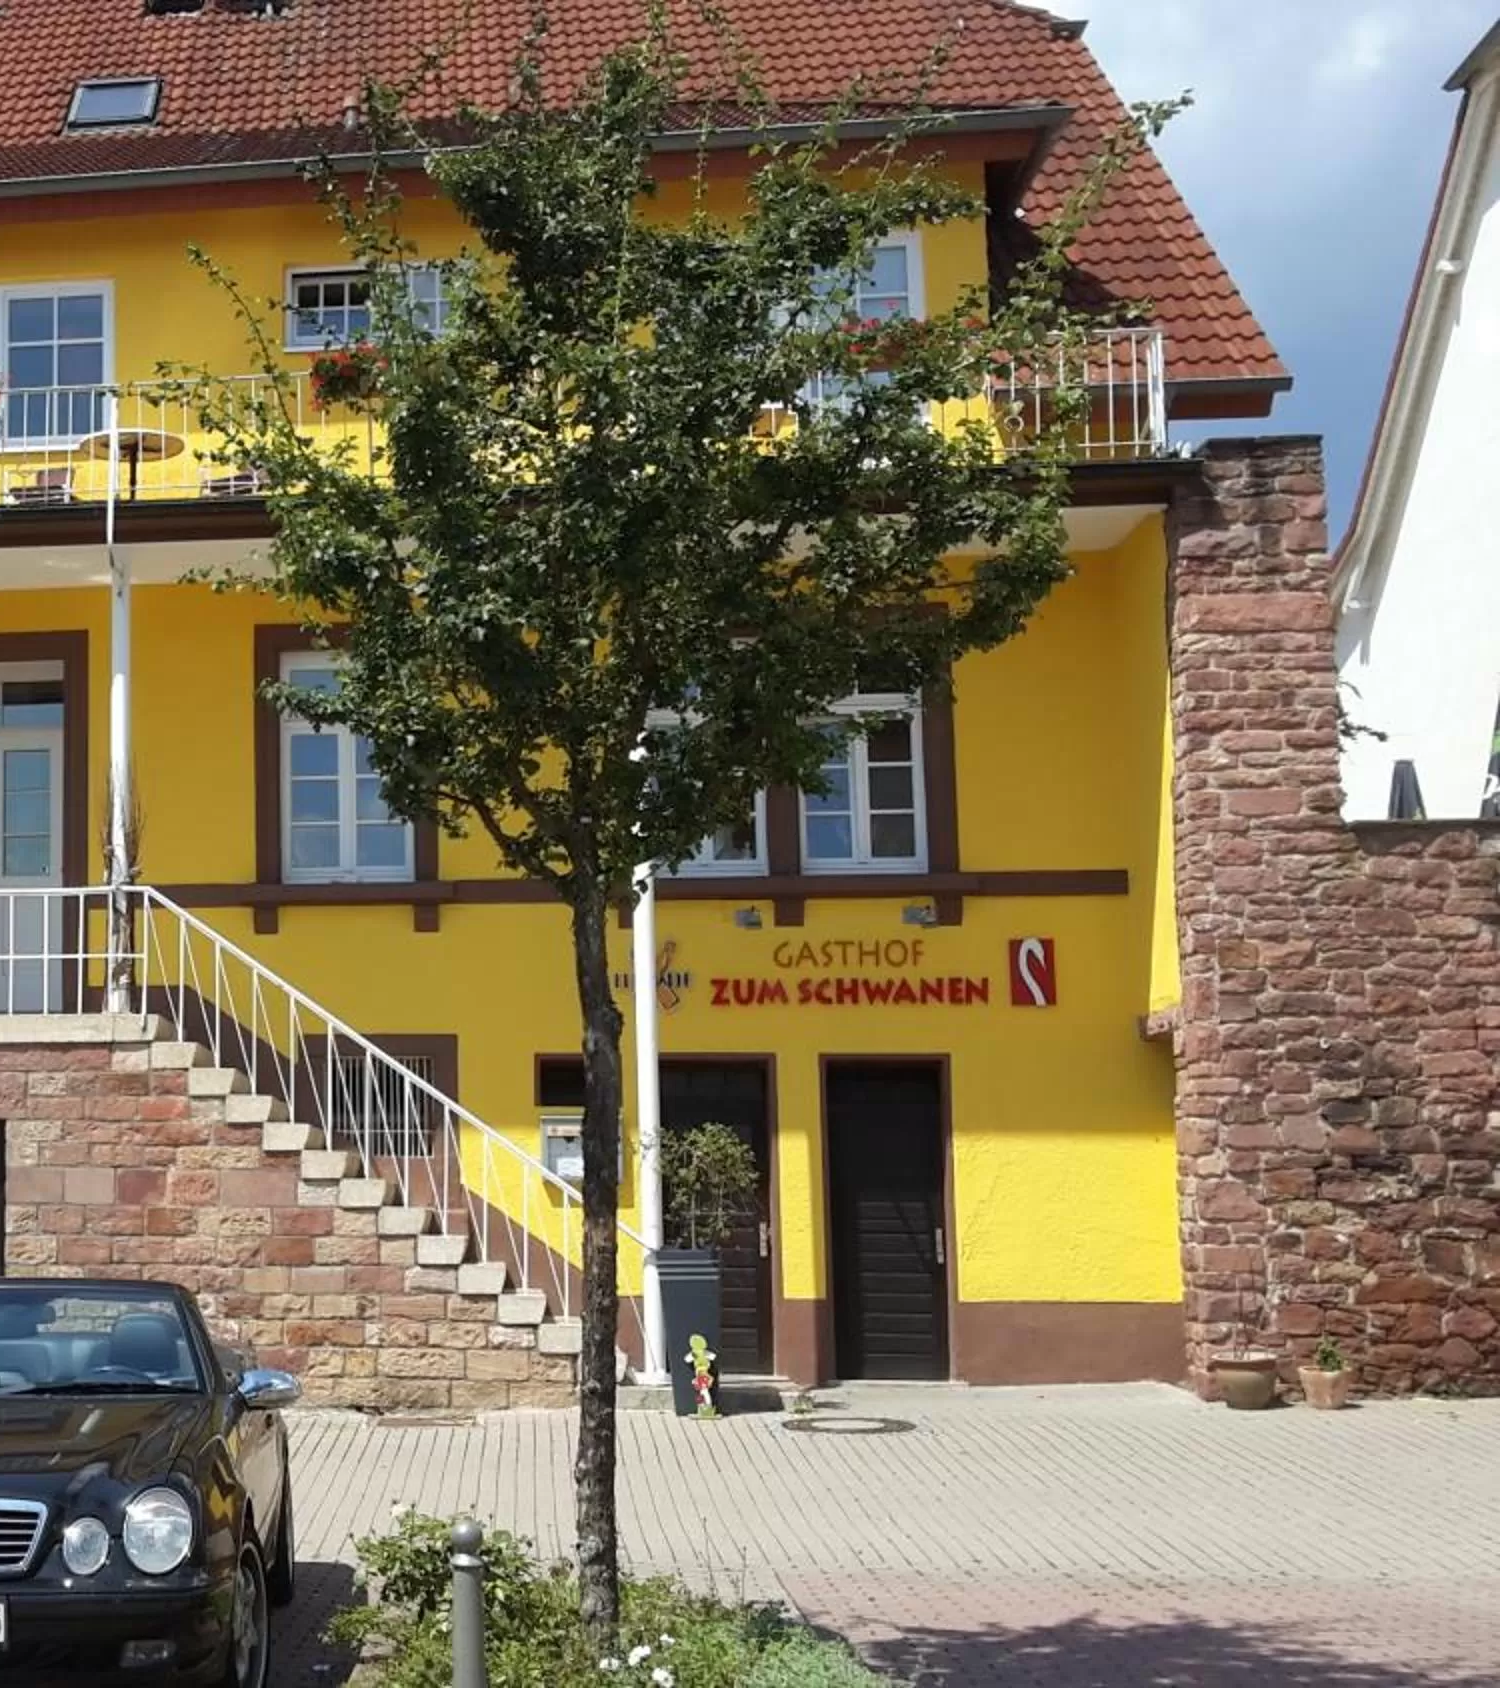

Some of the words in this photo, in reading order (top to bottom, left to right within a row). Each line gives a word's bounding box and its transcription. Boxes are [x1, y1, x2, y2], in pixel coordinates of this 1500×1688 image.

[772, 939, 925, 968] GASTHOF
[709, 978, 788, 1006] ZUM
[797, 976, 990, 1006] SCHWANEN
